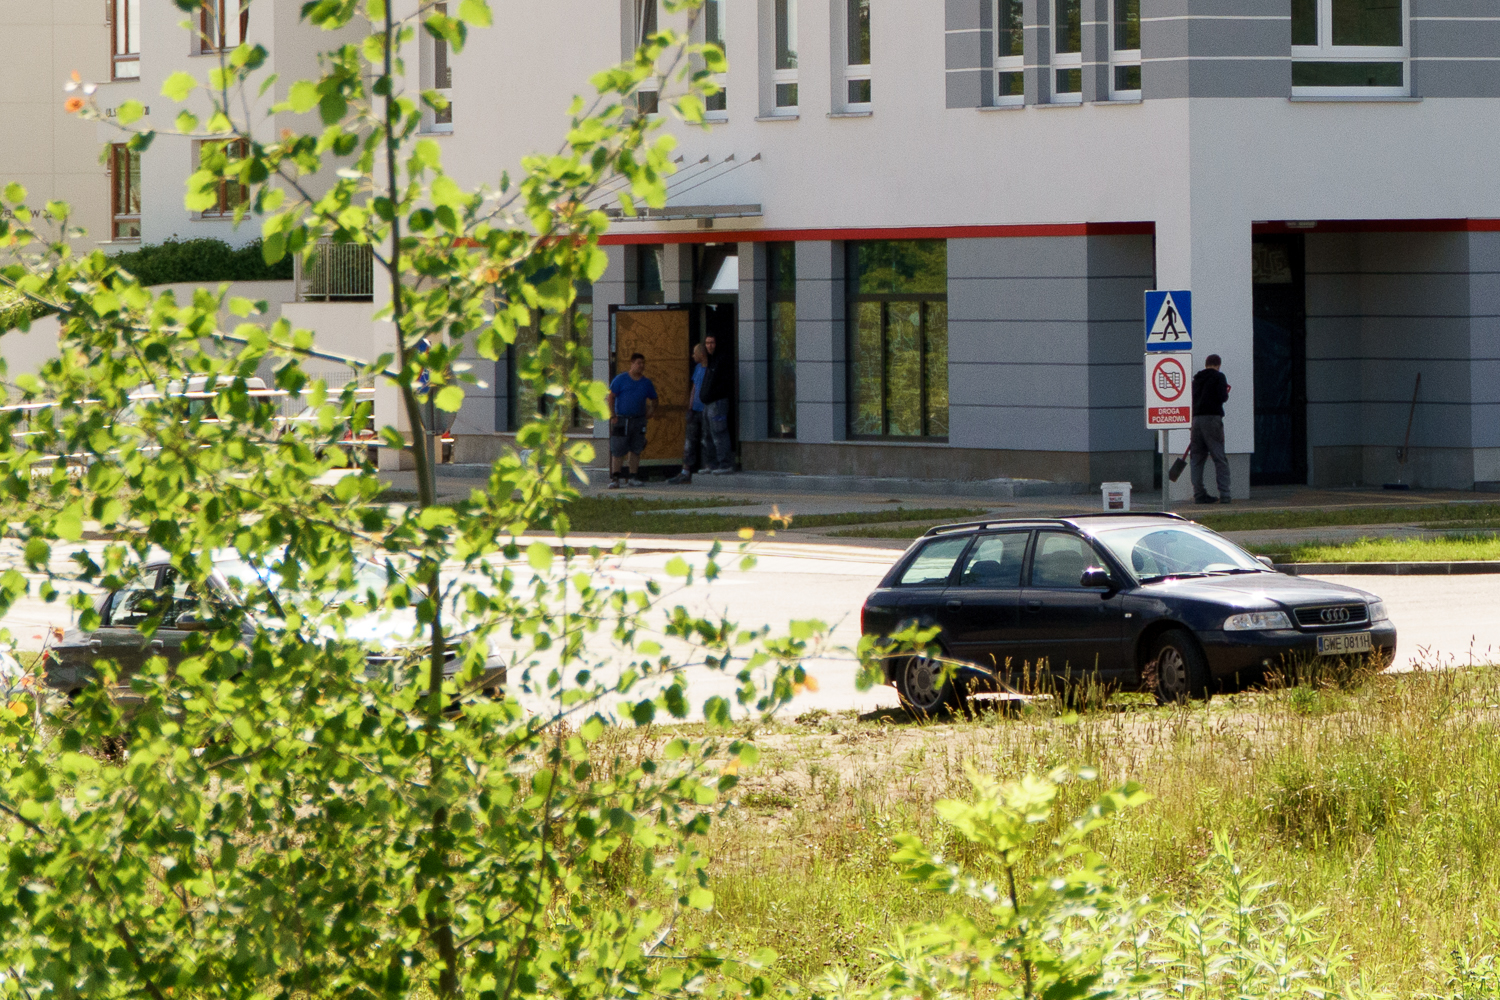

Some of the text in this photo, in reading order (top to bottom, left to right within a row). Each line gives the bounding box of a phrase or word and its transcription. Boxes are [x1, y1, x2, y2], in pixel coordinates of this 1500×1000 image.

[1158, 408, 1180, 416] DROGA
[1152, 414, 1186, 424] POŻAROWA
[1323, 637, 1342, 651] GWE
